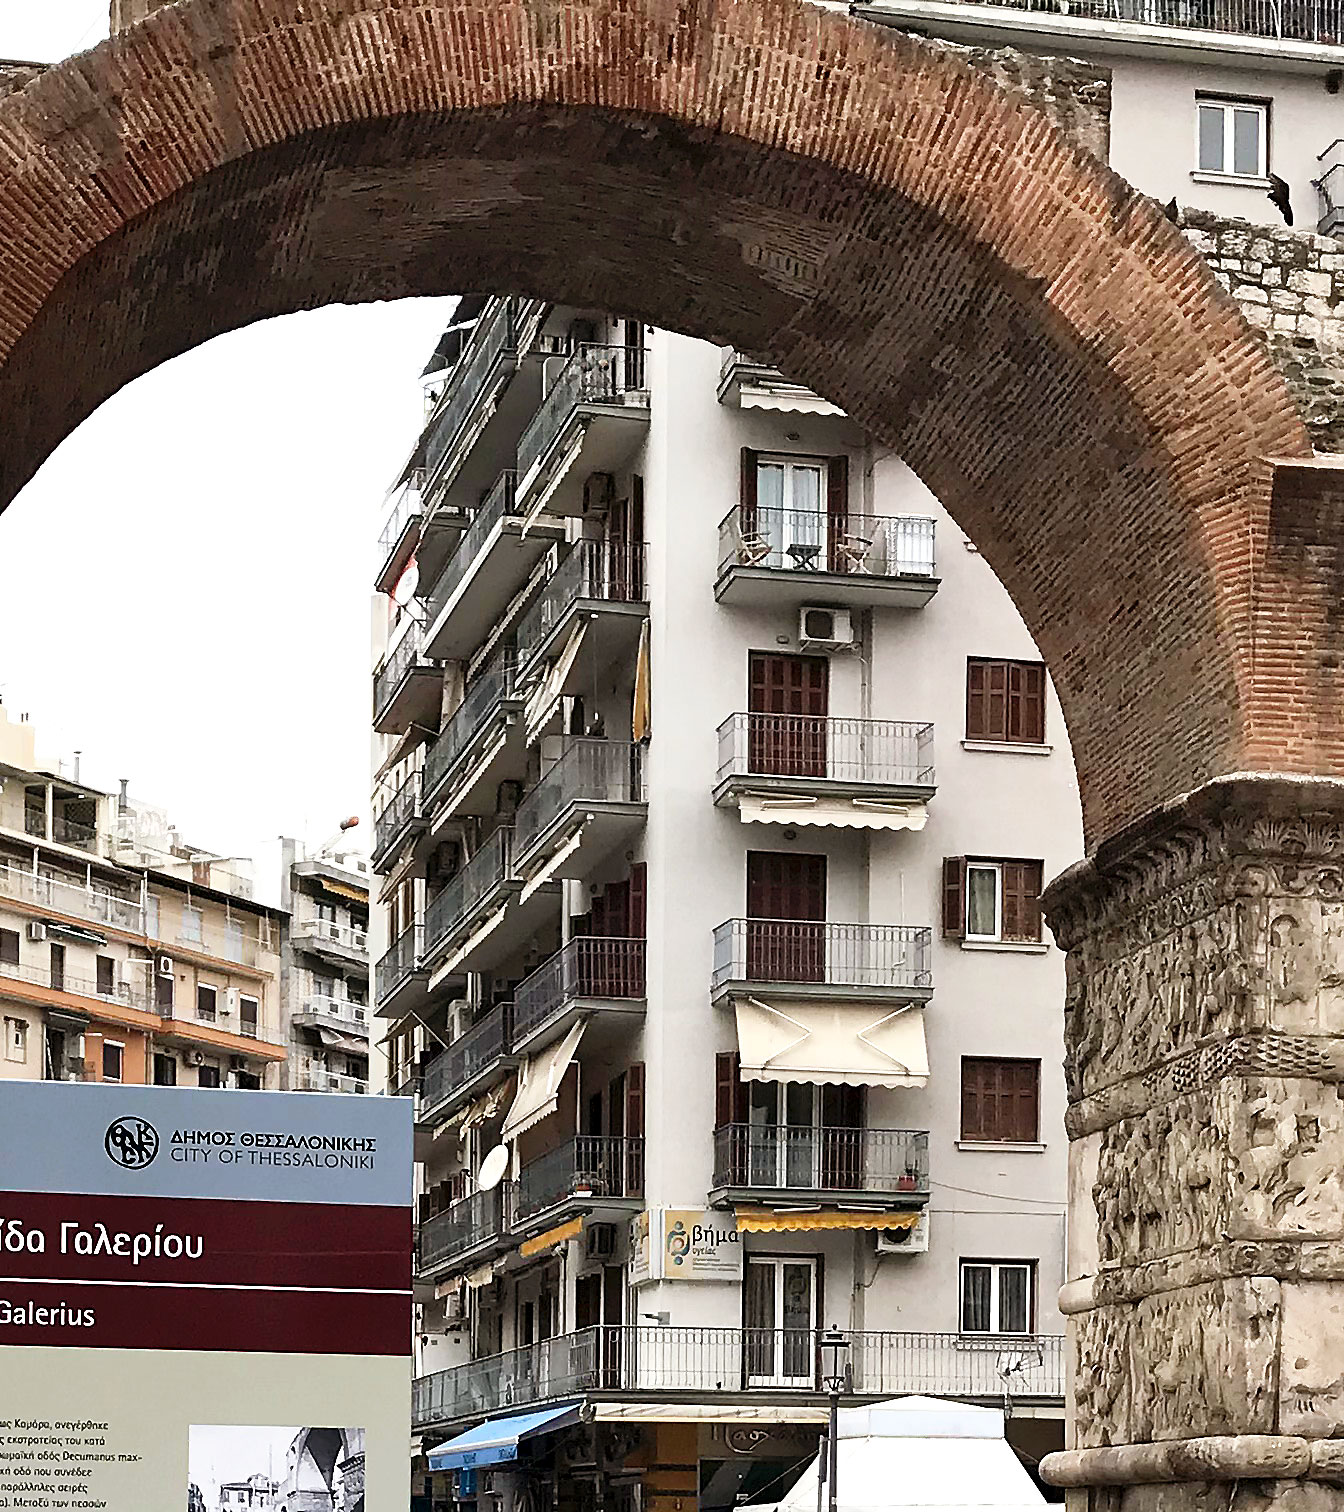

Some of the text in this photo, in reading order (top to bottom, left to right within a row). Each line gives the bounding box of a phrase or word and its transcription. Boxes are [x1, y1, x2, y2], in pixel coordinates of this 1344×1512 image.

[170, 1129, 377, 1153] ΔΗΜΟΣ ΘΕΣΣΑΛΟΝΙΚΗΣ
[170, 1147, 375, 1170] CITY OF THESSALONIKI
[58, 1222, 205, 1267] Γαλερίου
[692, 1223, 740, 1247] βήμα
